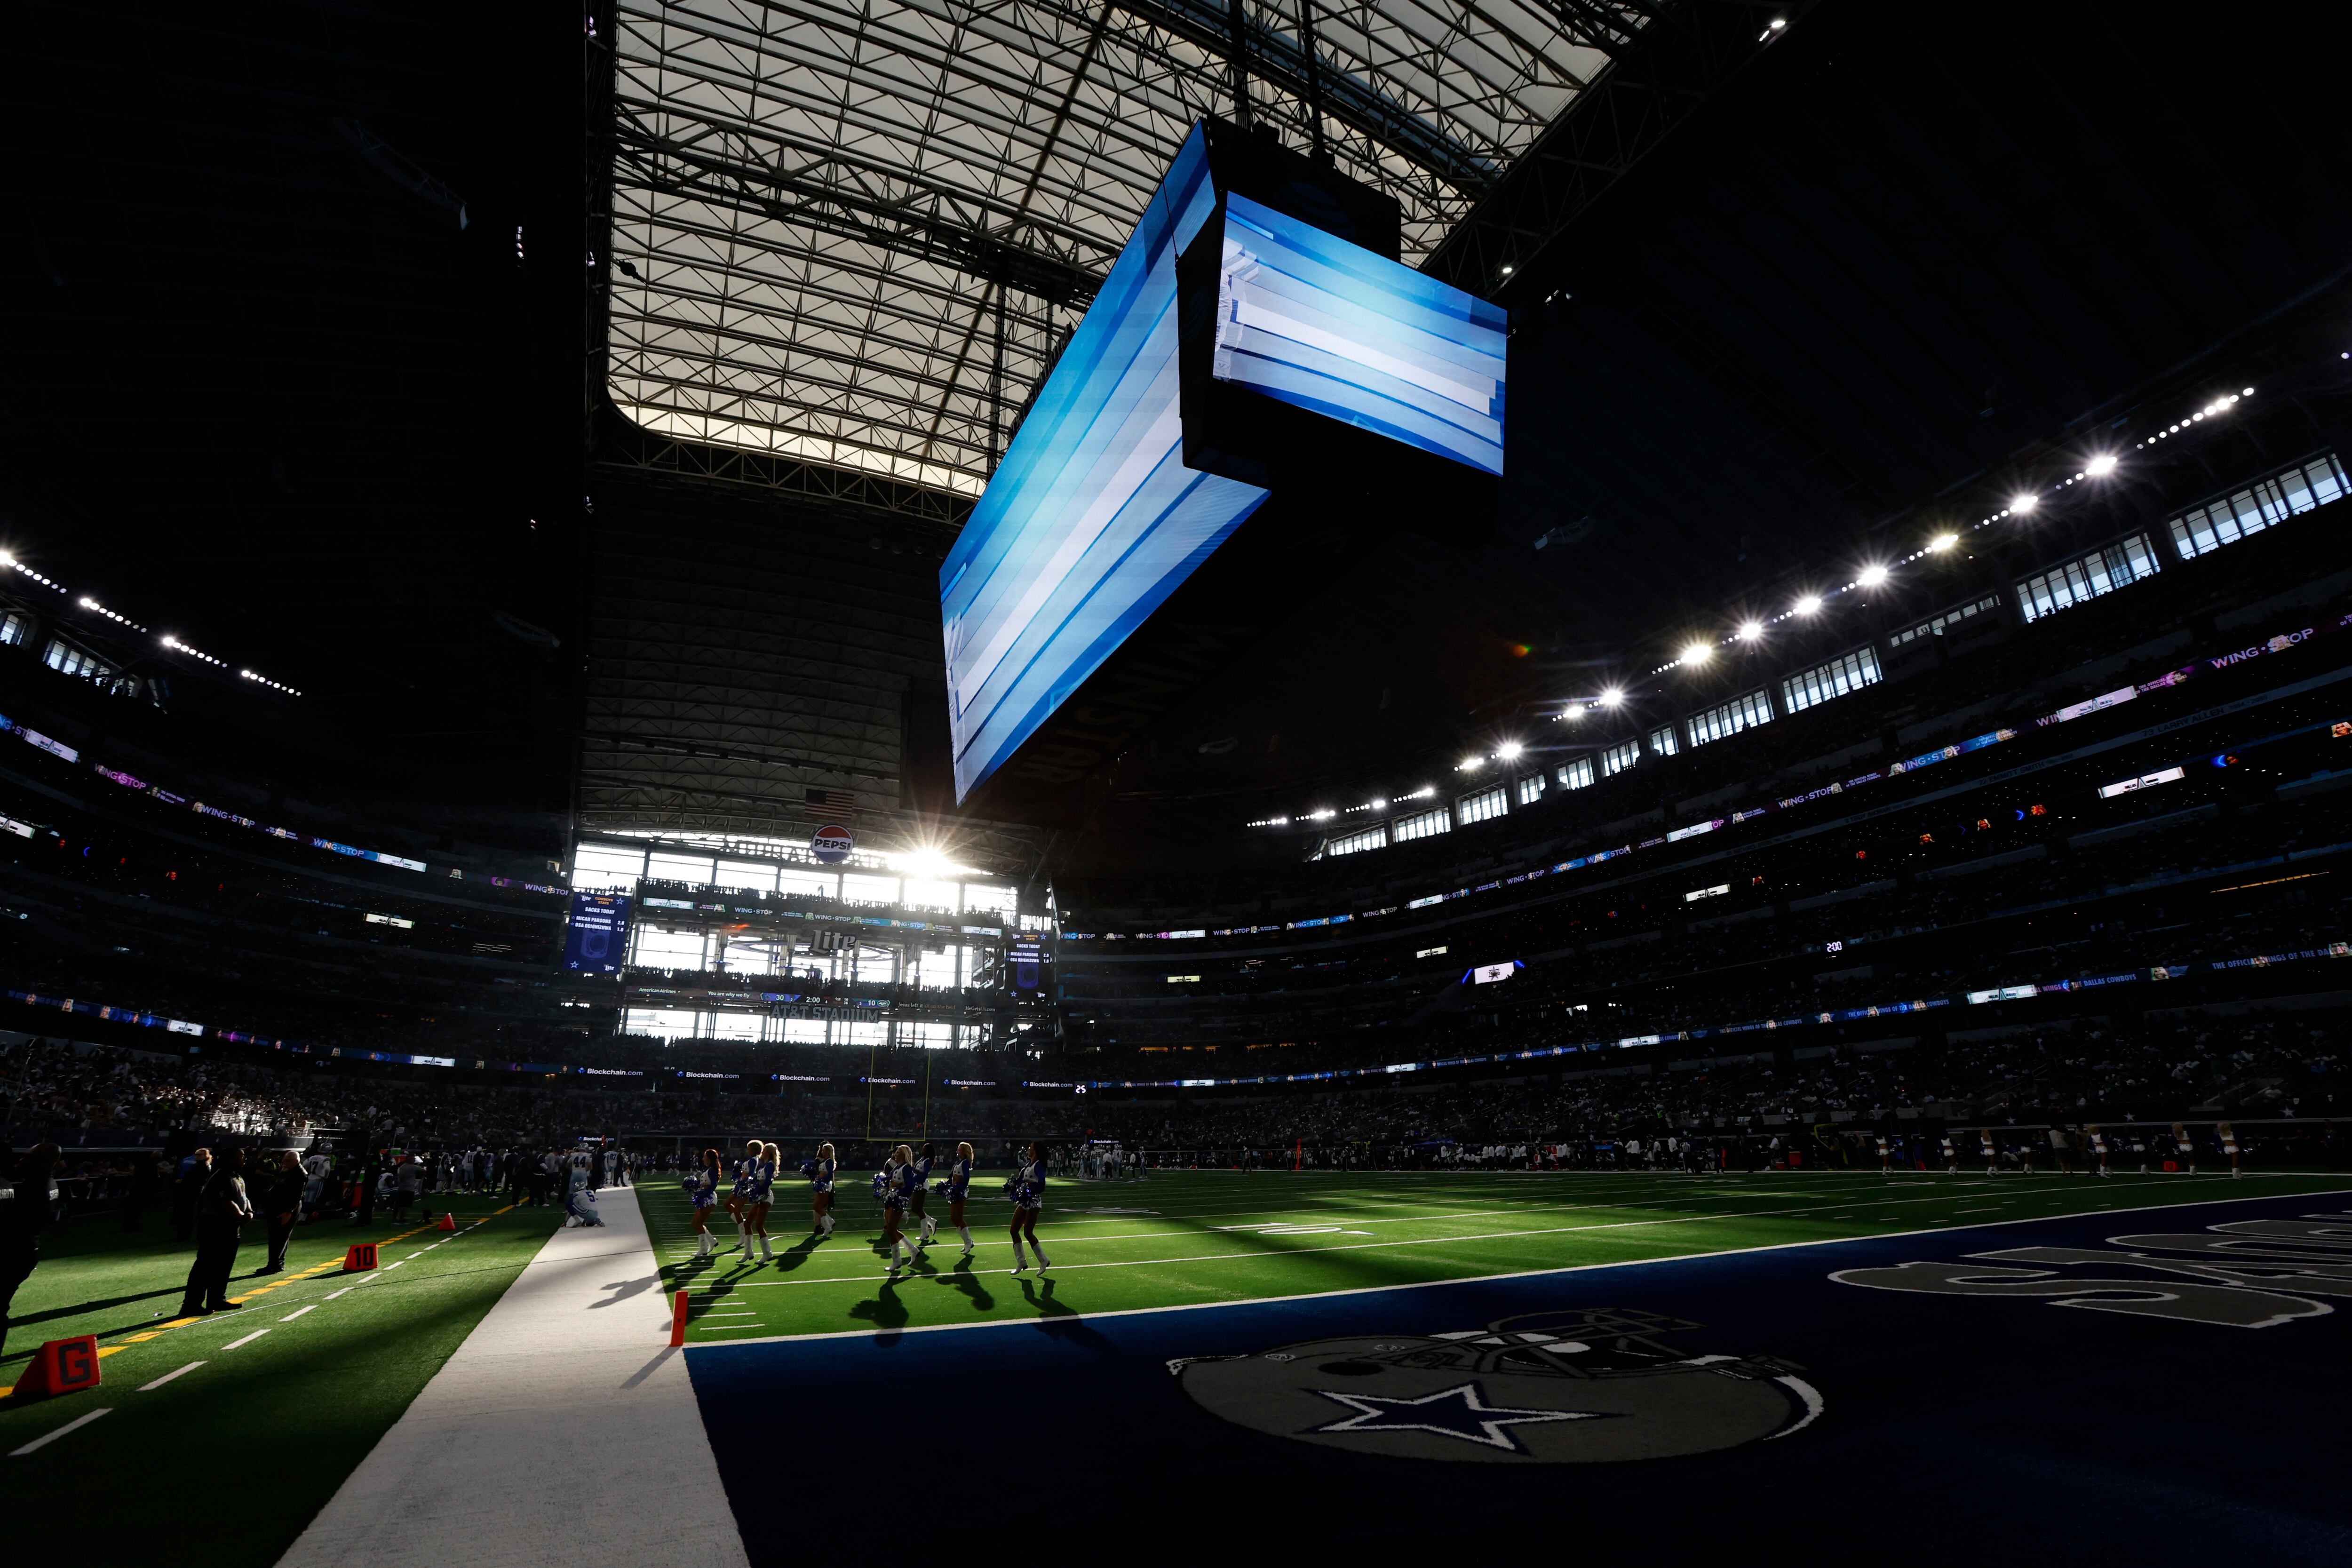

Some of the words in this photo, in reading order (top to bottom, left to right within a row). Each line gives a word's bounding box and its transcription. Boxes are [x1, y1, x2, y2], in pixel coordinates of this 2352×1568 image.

[814, 839, 850, 850] PEPSI
[810, 930, 856, 954] Lite
[1827, 941, 1843, 952] 2:00
[2288, 952, 2298, 960] OF
[2300, 949, 2316, 958] THE
[2083, 978, 2105, 987] DALLAS
[2107, 973, 2137, 984] COWBOYS
[770, 1004, 809, 1019] AT&T
[812, 1006, 879, 1022] STADIUM
[1075, 1085, 1086, 1094] 25
[573, 1156, 586, 1168] 44
[586, 1192, 595, 1202] 5
[354, 1246, 373, 1267] 10
[58, 1341, 91, 1386] G
